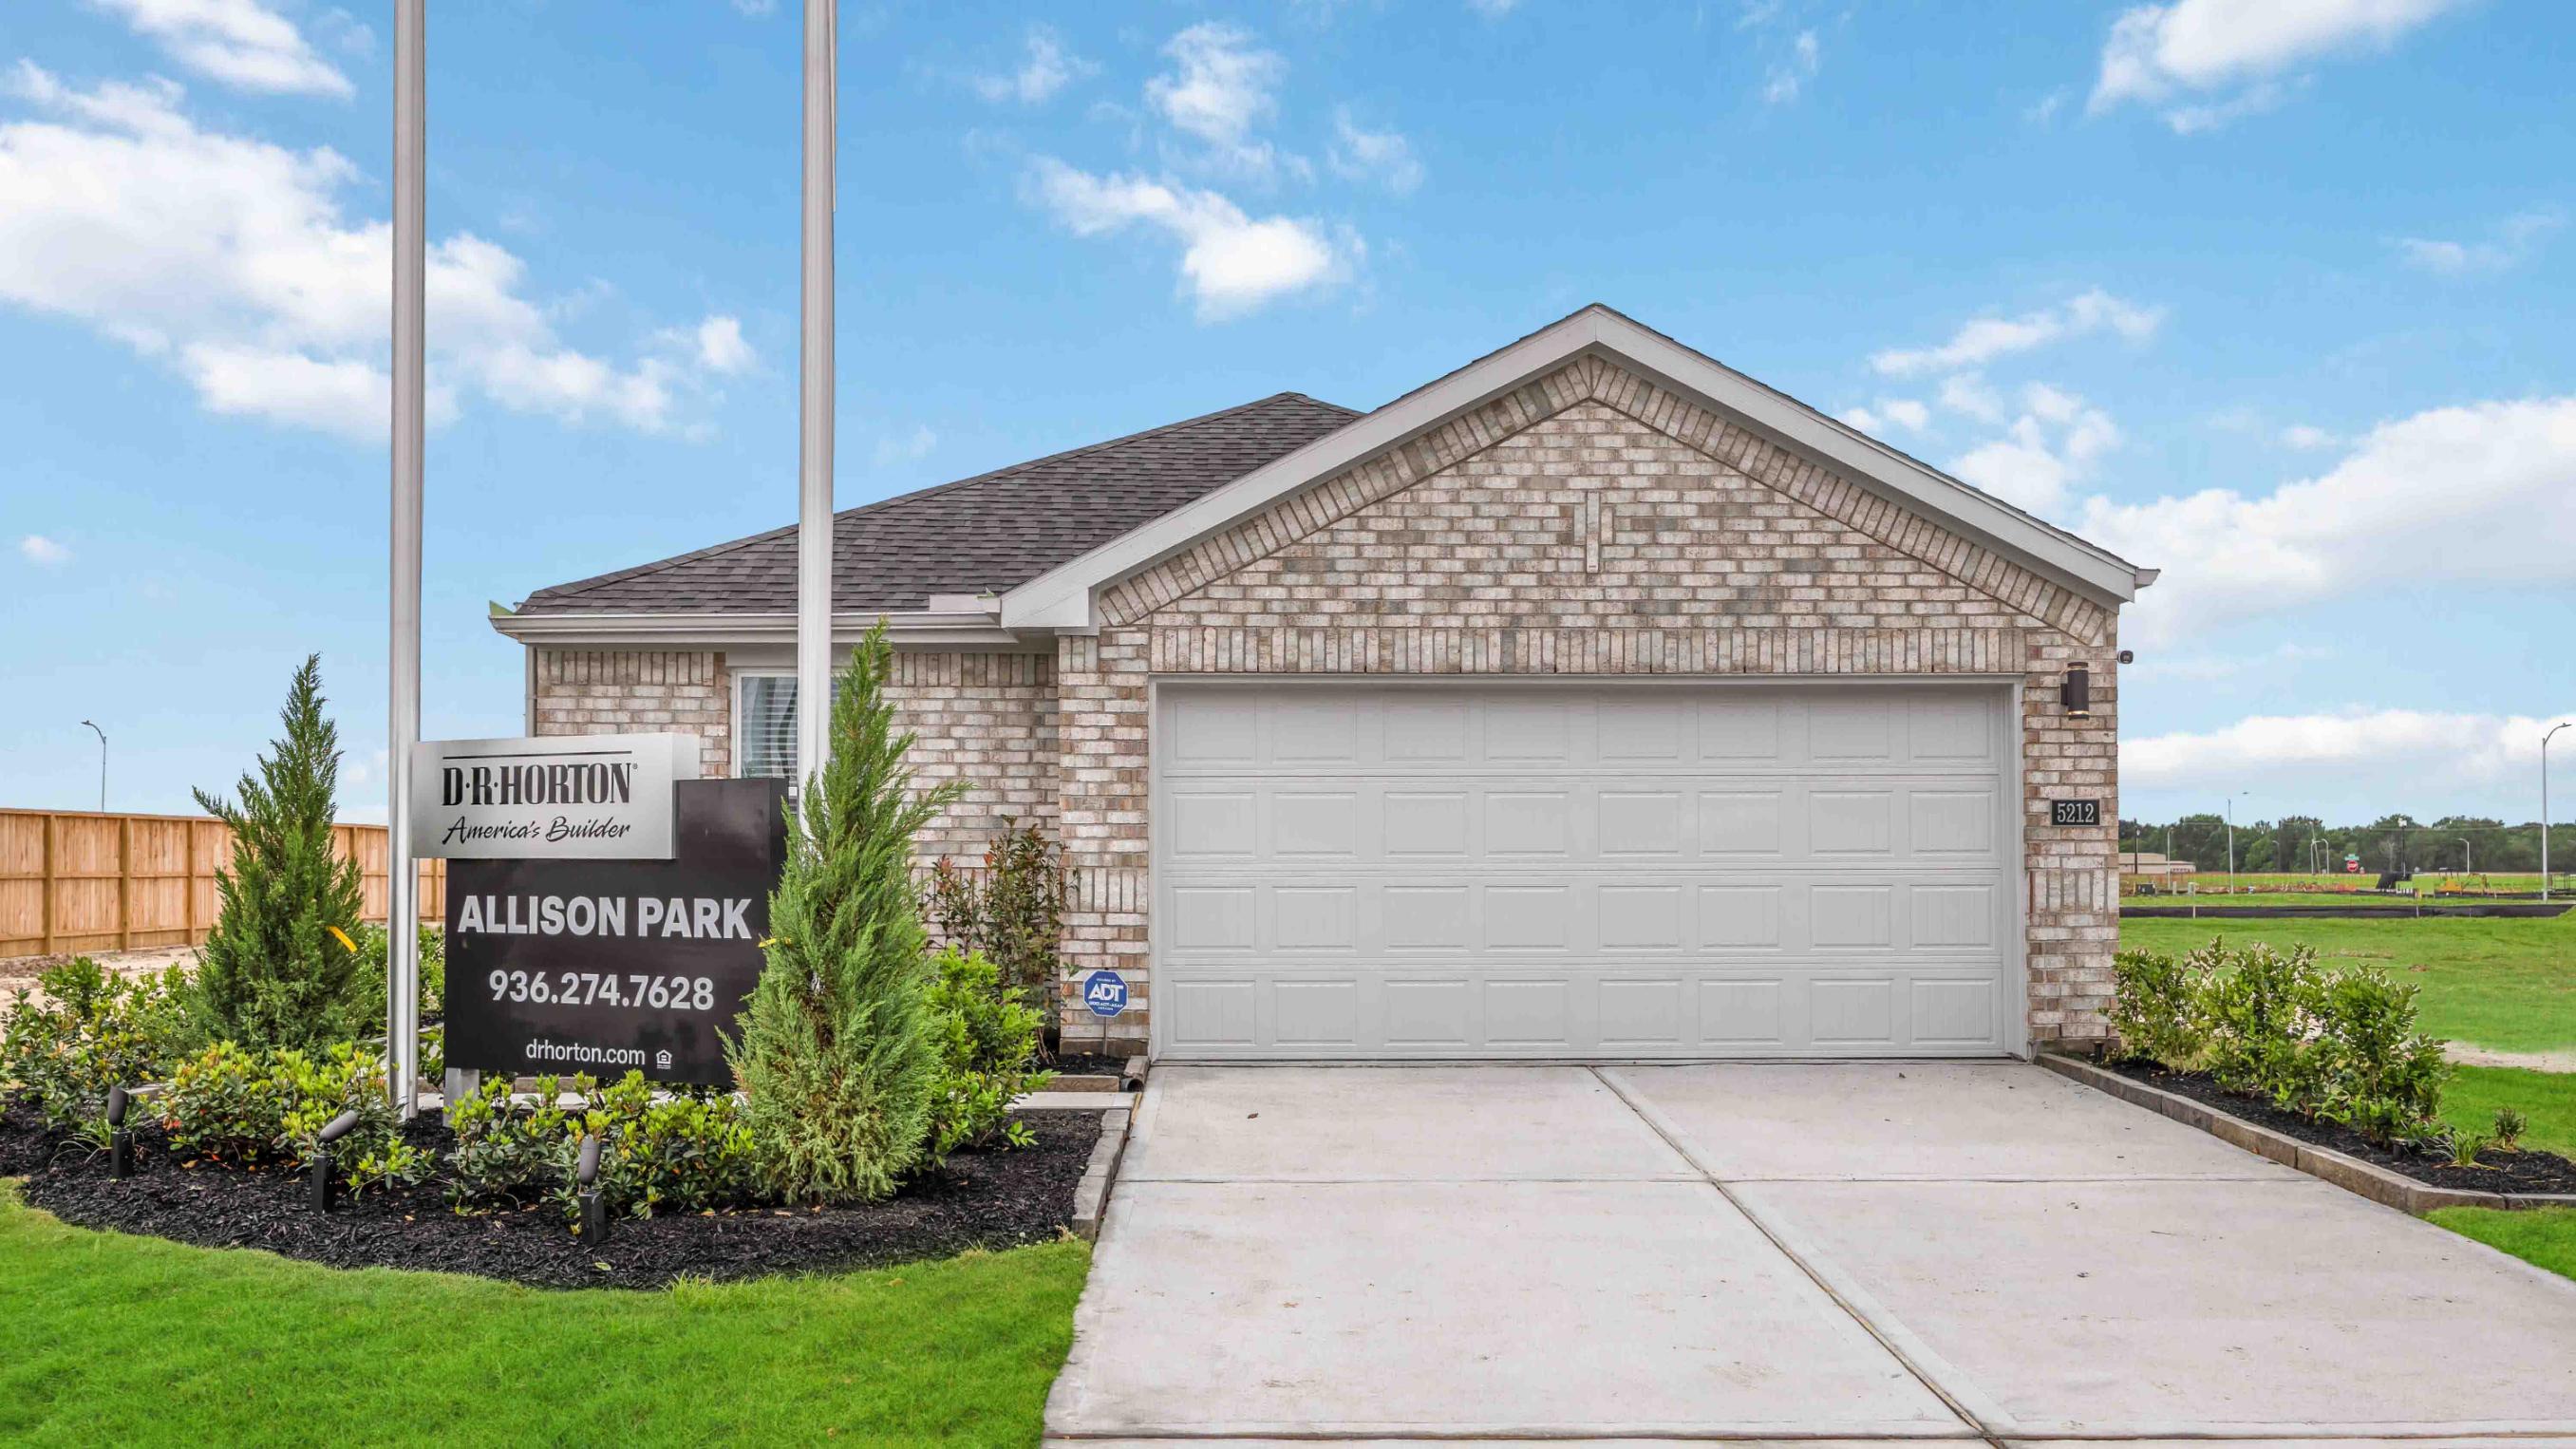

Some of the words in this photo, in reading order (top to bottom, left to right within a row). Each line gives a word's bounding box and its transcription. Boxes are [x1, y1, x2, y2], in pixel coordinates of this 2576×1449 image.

[2057, 802, 2095, 823] 5212
[442, 815, 541, 844] America's
[545, 815, 631, 843] Builder
[457, 894, 627, 936] ALLISON
[637, 896, 752, 939] PARK
[489, 969, 715, 1010] 936.274.7628
[1088, 983, 1124, 1002] ADT
[525, 1038, 646, 1065] drhorton.com
